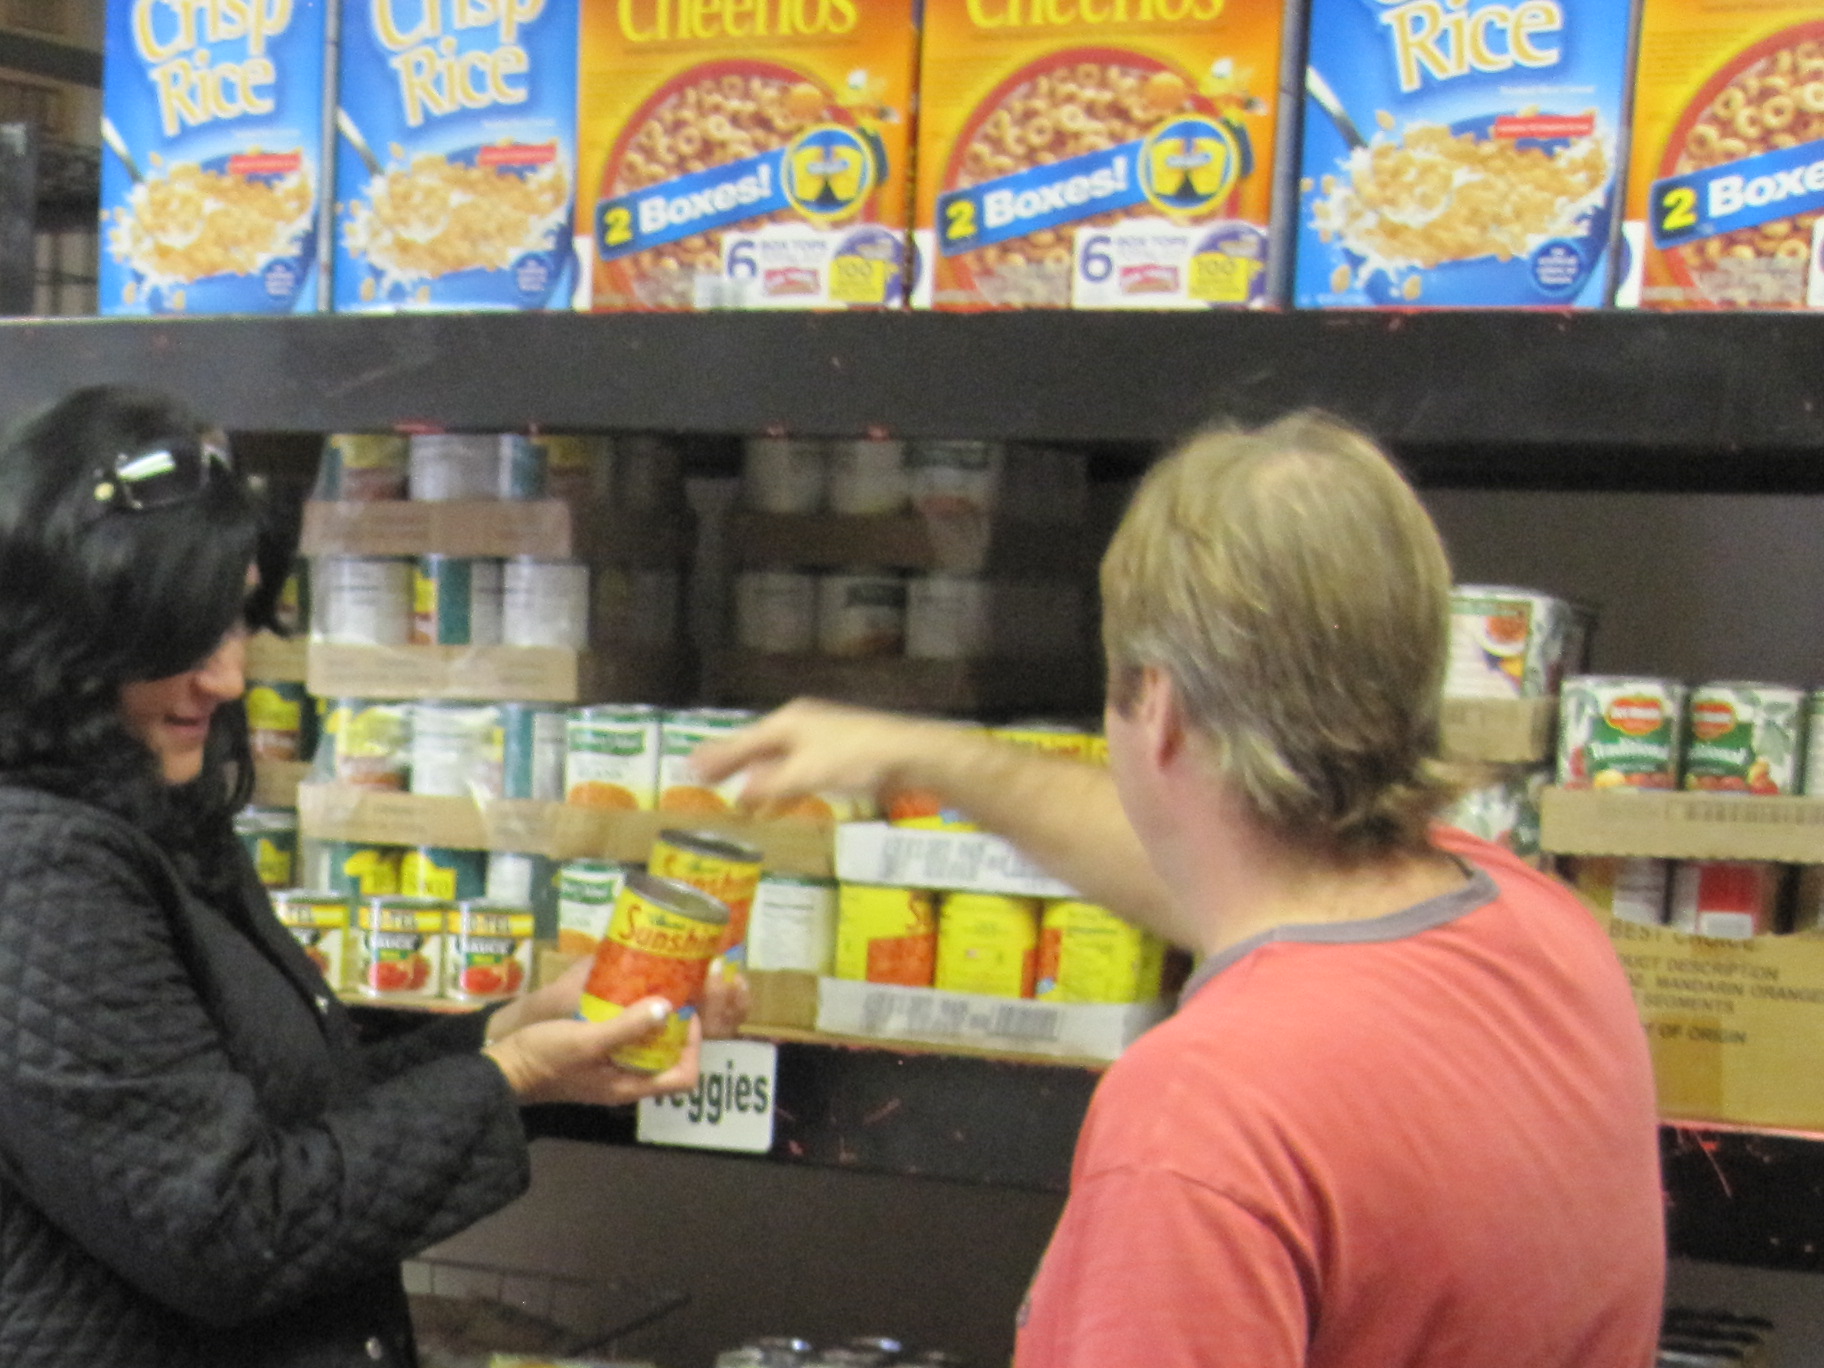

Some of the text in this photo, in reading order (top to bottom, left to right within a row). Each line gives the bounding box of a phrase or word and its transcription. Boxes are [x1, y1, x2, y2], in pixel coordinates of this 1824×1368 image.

[389, 36, 529, 127] Rice
[1380, 0, 1563, 93] Rice
[149, 49, 276, 137] Rice
[604, 163, 773, 246] 2 Boxes!
[946, 156, 1128, 240] 2 Boxes!
[1662, 187, 1698, 231] 2
[1080, 235, 1113, 283] 6
[654, 1059, 768, 1124] ggies
